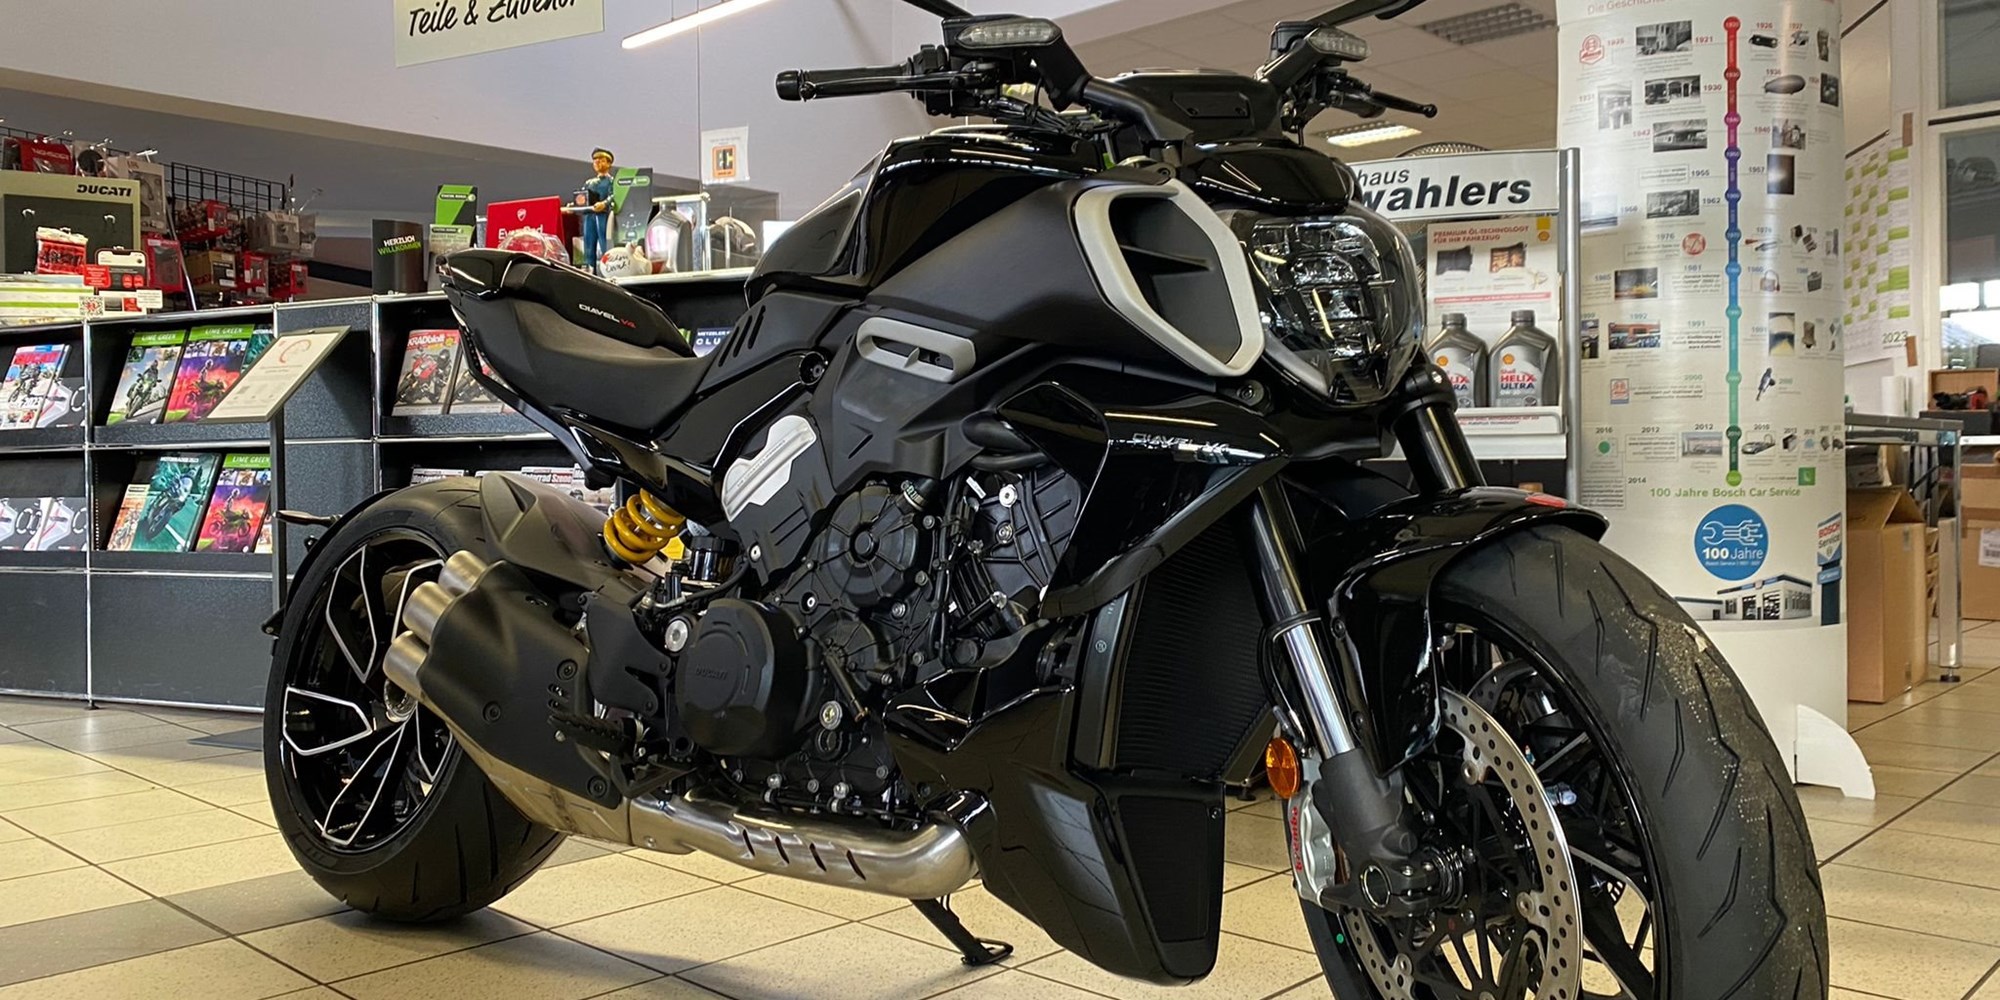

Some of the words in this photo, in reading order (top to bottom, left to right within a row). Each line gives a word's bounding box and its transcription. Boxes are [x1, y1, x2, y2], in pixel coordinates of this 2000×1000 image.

[409, 1, 458, 36] Teile
[463, 0, 479, 26] &
[1695, 36, 1714, 44] 1921
[1357, 169, 1410, 187] haus
[76, 184, 132, 197] DUCATI
[1433, 228, 1467, 238] PREMIUM
[384, 235, 415, 247] HERZLICH
[1433, 236, 1447, 244] FÜR
[578, 303, 620, 324] DIAVEL
[620, 318, 636, 328] V4
[1882, 330, 1908, 344] 2023
[1500, 374, 1537, 382] HELIX
[1650, 489, 1670, 497] 100
[1676, 488, 1708, 497] Jahre
[1713, 488, 1745, 497] Bosch
[1750, 488, 1766, 496] Car
[1770, 487, 1801, 496] Service
[1819, 522, 1840, 537] BOSCH
[1818, 535, 1840, 548] Service
[1702, 548, 1729, 559] 100
[1730, 547, 1763, 560] Jahre
[1291, 806, 1303, 872] brembo
